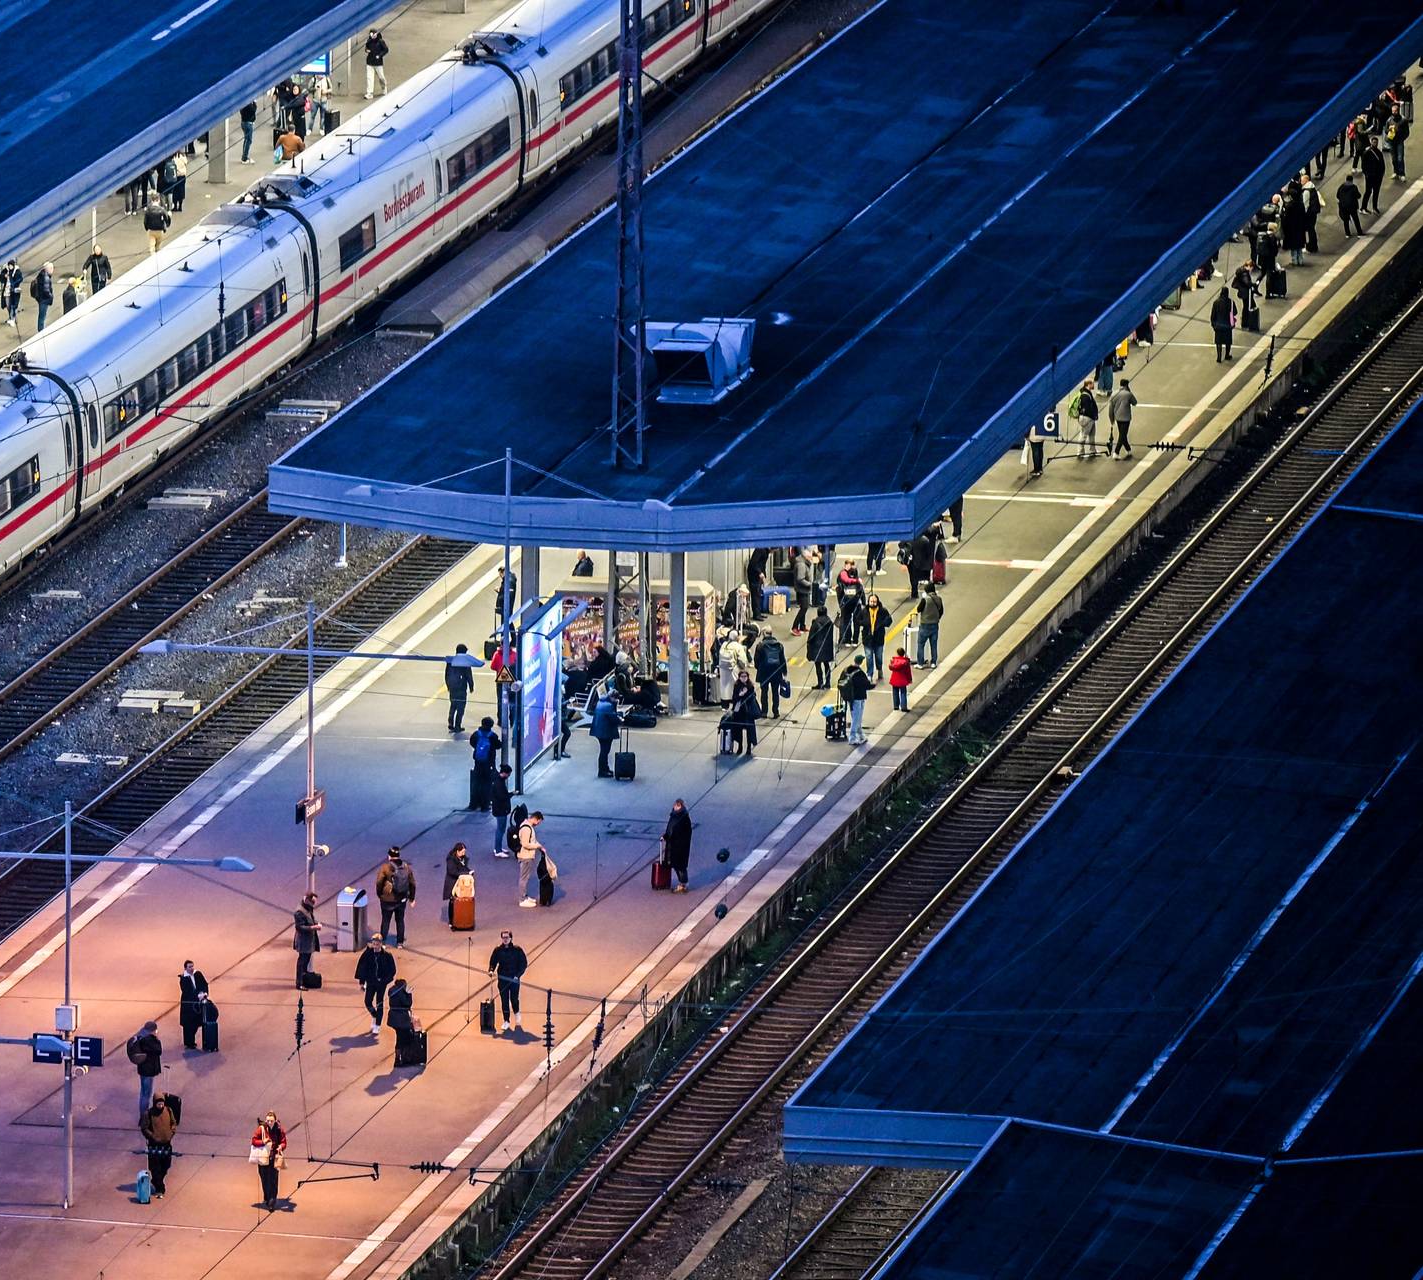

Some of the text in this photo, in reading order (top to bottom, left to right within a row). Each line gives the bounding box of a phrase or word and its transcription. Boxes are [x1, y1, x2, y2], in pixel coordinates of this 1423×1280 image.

[383, 178, 426, 223] Bordrestaurant
[1043, 413, 1056, 432] 6
[78, 1038, 91, 1060] E
